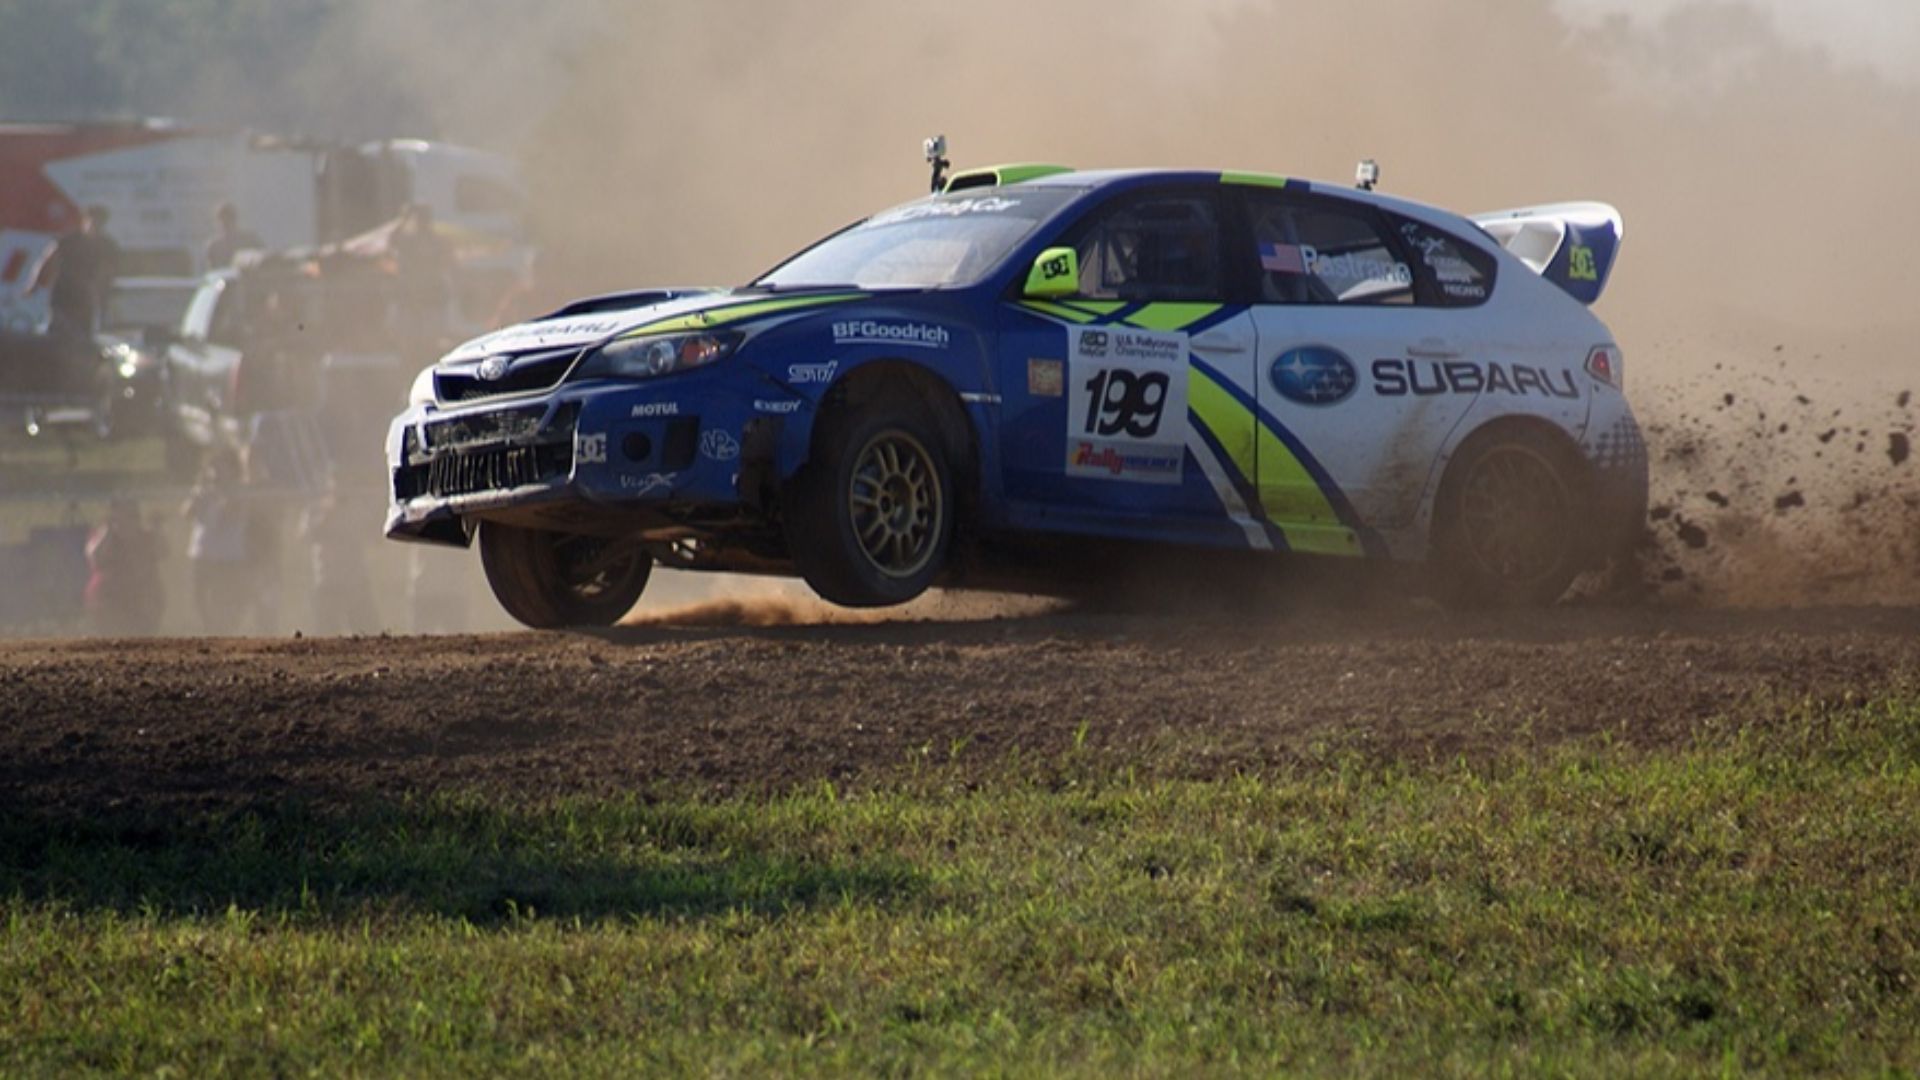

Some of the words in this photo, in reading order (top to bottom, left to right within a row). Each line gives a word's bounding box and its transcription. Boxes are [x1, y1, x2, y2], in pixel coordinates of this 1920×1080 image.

[1569, 245, 1597, 281] DC
[832, 320, 950, 343] BFGoodrich
[1371, 359, 1580, 398] SUBARU
[631, 402, 679, 417] MOTUL
[1084, 368, 1170, 439] 199
